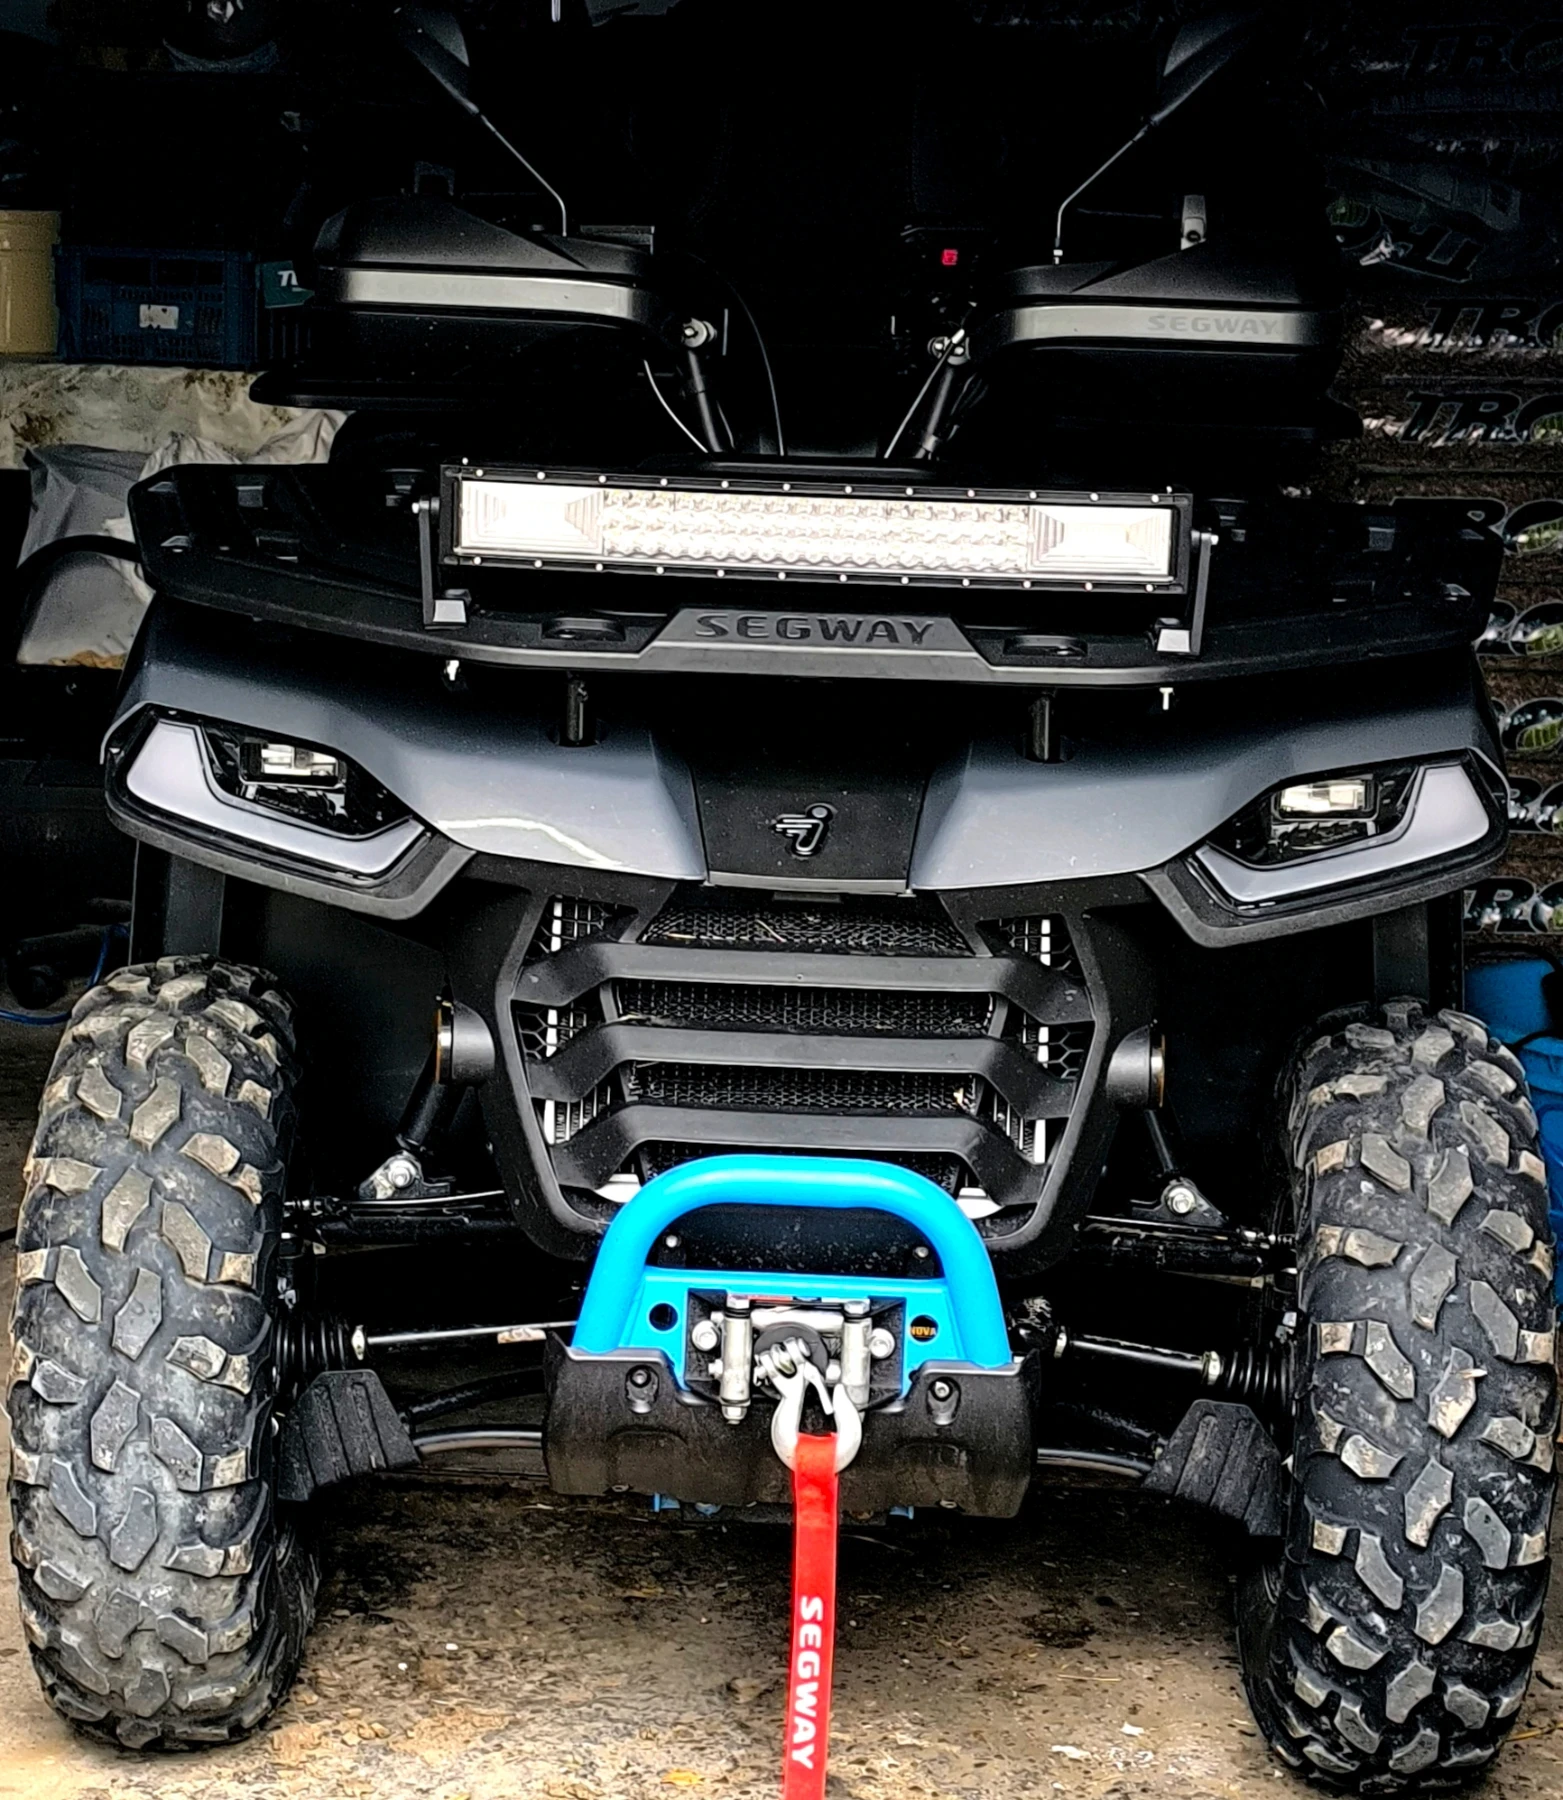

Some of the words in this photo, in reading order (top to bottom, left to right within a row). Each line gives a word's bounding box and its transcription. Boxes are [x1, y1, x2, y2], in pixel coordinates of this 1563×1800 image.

[1147, 315, 1278, 335] SEGWAY
[695, 612, 935, 646] SEGWAY
[791, 1595, 824, 1770] SEGWAY
